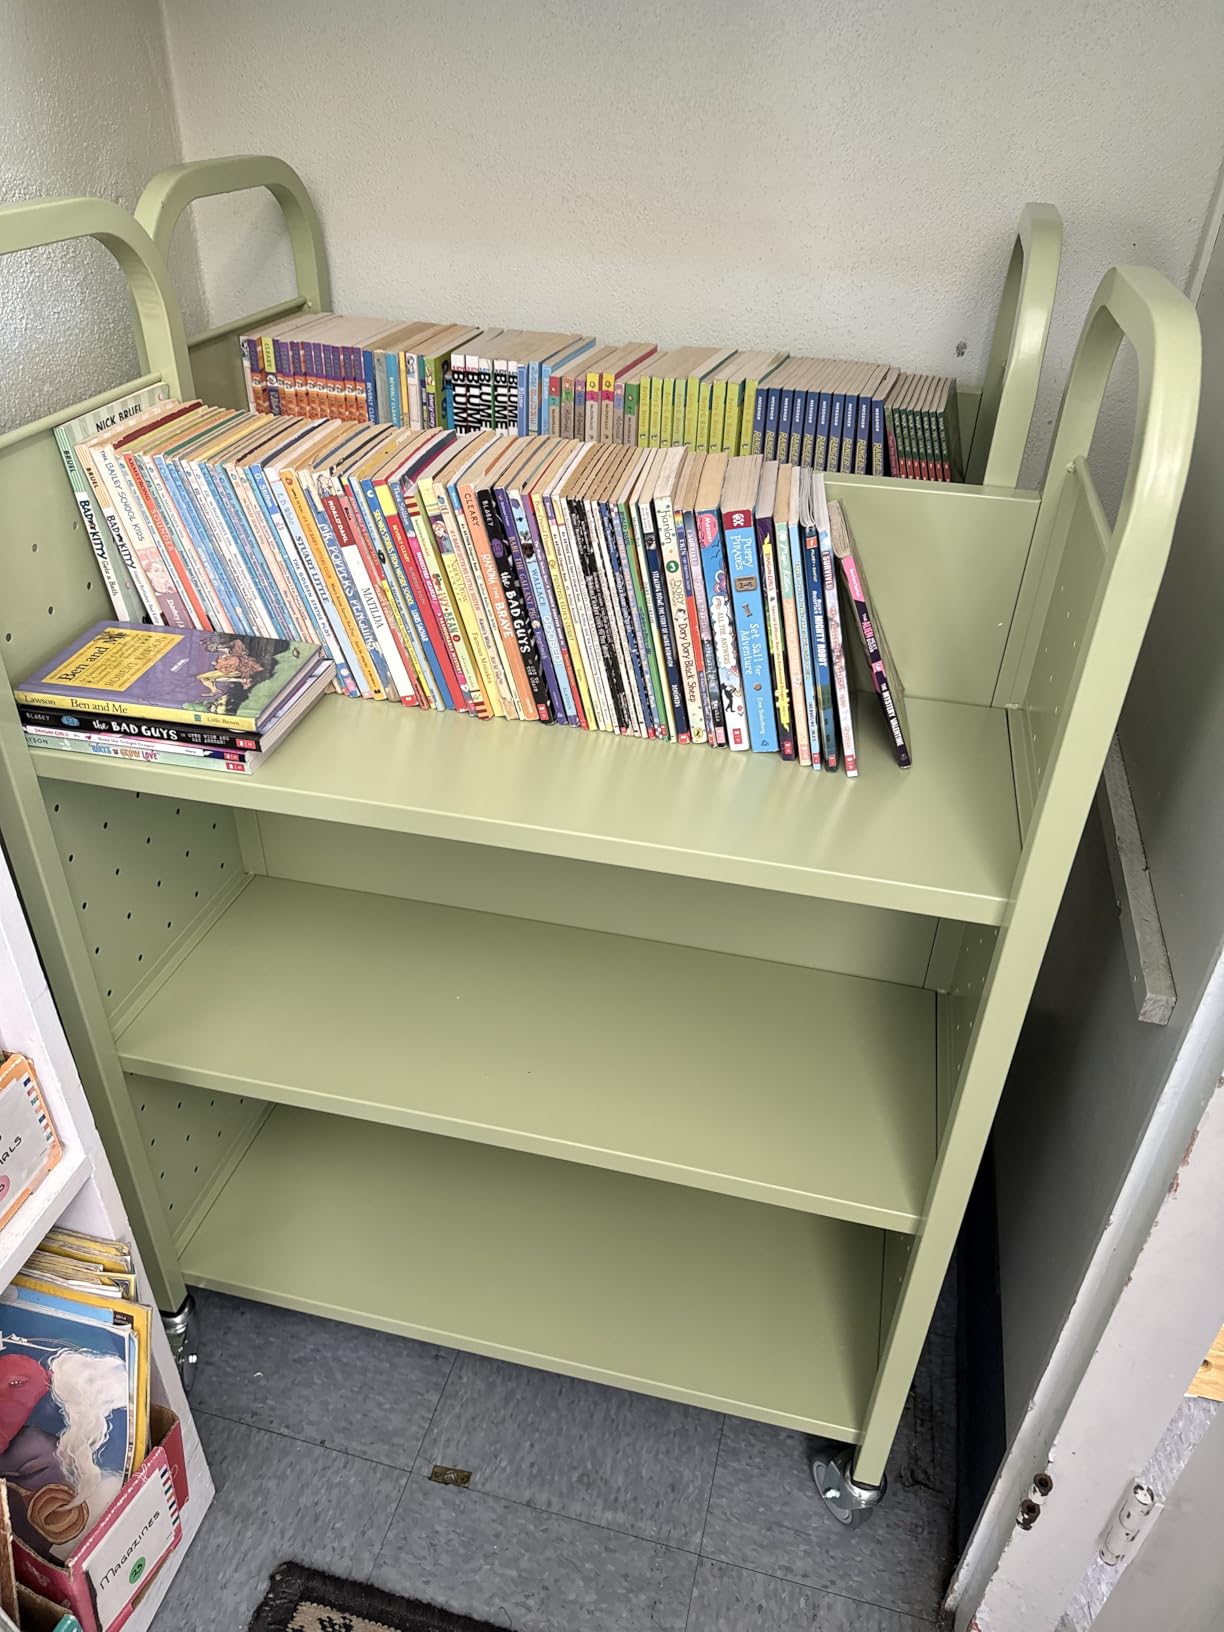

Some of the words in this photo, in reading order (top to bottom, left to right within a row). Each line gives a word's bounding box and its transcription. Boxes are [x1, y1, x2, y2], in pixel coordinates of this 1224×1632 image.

[452, 374, 466, 434] BLUME
[480, 373, 492, 428] BLUME
[494, 374, 508, 430] BLUME
[508, 376, 518, 428] BLUME
[96, 415, 116, 432] NICK
[118, 404, 142, 421] BRUEL
[766, 431, 774, 458] RANGER
[778, 432, 788, 459] RANGER
[791, 432, 800, 460] RANGER
[803, 434, 812, 461] RANGER
[816, 435, 826, 462] RANGER
[829, 436, 838, 464] RANGER
[842, 437, 852, 464] RANGER
[857, 439, 866, 466] RANGER
[873, 443, 882, 470] RANGER
[64, 450, 75, 472] BRUEL
[86, 467, 98, 489] BRUEL
[126, 456, 151, 501] ARMSTRONG
[105, 463, 122, 490] BAILEY
[119, 492, 136, 522] SCHOOL
[132, 523, 144, 542] KIDS
[258, 483, 273, 508] Stilton
[392, 485, 403, 502] Thea
[463, 492, 479, 527] CLEARY
[482, 499, 493, 526] BLABEY
[80, 500, 96, 522] BAD
[90, 531, 108, 560] KITTY
[150, 508, 174, 552] SOUNDER
[337, 524, 348, 544] DAHL
[659, 509, 673, 544] hanlon
[705, 516, 713, 543] Messner
[106, 514, 120, 536] BAD
[118, 540, 136, 570] KITTY
[391, 523, 403, 545] BEVERLY
[399, 544, 410, 563] CLEARY
[731, 535, 743, 570] PIRATES
[740, 537, 753, 568] PUPPY
[294, 534, 314, 572] STUART
[310, 572, 329, 604] LITTLE
[372, 509, 387, 534] SIDEWAYS
[381, 533, 394, 553] STORIES
[389, 552, 400, 567] FROM
[402, 586, 414, 606] SCHOOL
[410, 608, 421, 623] LOUIS
[416, 622, 428, 642] SACHAR
[500, 570, 512, 588] the
[508, 535, 518, 553] BABE
[514, 557, 523, 570] THE
[519, 572, 533, 605] GALLANT
[528, 606, 537, 619] PIG
[823, 555, 833, 590] SURVIVED
[292, 558, 300, 570] THE
[297, 570, 312, 597] GOLDEN
[309, 598, 323, 621] STATUE
[320, 622, 330, 637] PLOT
[470, 592, 480, 610] SISTER
[480, 553, 497, 584] RAMONA
[494, 601, 512, 639] BRAVE
[530, 568, 546, 606] WALLACE
[673, 579, 684, 605] DORY
[361, 586, 383, 628] MATILDA
[505, 590, 522, 623] BAD
[652, 570, 661, 591] STEALING
[659, 614, 667, 627] STORY
[665, 646, 674, 667] ROBINSON
[715, 611, 724, 623] ALL
[349, 597, 377, 650] PENGUINS
[425, 579, 437, 601] ACADEMY
[438, 616, 455, 652] FASHIONABLE
[451, 651, 462, 674] MYSTERY
[444, 610, 459, 634] BEAN
[677, 622, 689, 641] Dory
[718, 624, 726, 636] THE
[749, 623, 760, 640] Set
[814, 615, 824, 642] MIGHTY
[861, 620, 874, 638] ALIEN
[471, 631, 484, 656] Famous
[515, 624, 531, 653] GUYS
[680, 642, 692, 660] Dory
[720, 636, 731, 665] ANSWERS
[740, 629, 754, 675] Adventure
[751, 643, 762, 662] Sail
[58, 664, 86, 681] Ben
[86, 646, 110, 665] and
[816, 642, 827, 667] ROBOT
[682, 660, 695, 680] Black
[24, 695, 56, 706] Lawson
[71, 698, 90, 709] Ben
[92, 701, 110, 712] and
[112, 704, 128, 714] Me
[686, 680, 698, 703] Sheep
[26, 712, 50, 721] BLABEY
[92, 720, 109, 730] the
[111, 722, 138, 734] BAD
[141, 726, 178, 740] GUYS
[881, 690, 896, 718] MYSTERY
[889, 718, 904, 746] VALENTINE
[142, 750, 158, 762] LOVE
[100, 1510, 160, 1590] MAGAZINES
